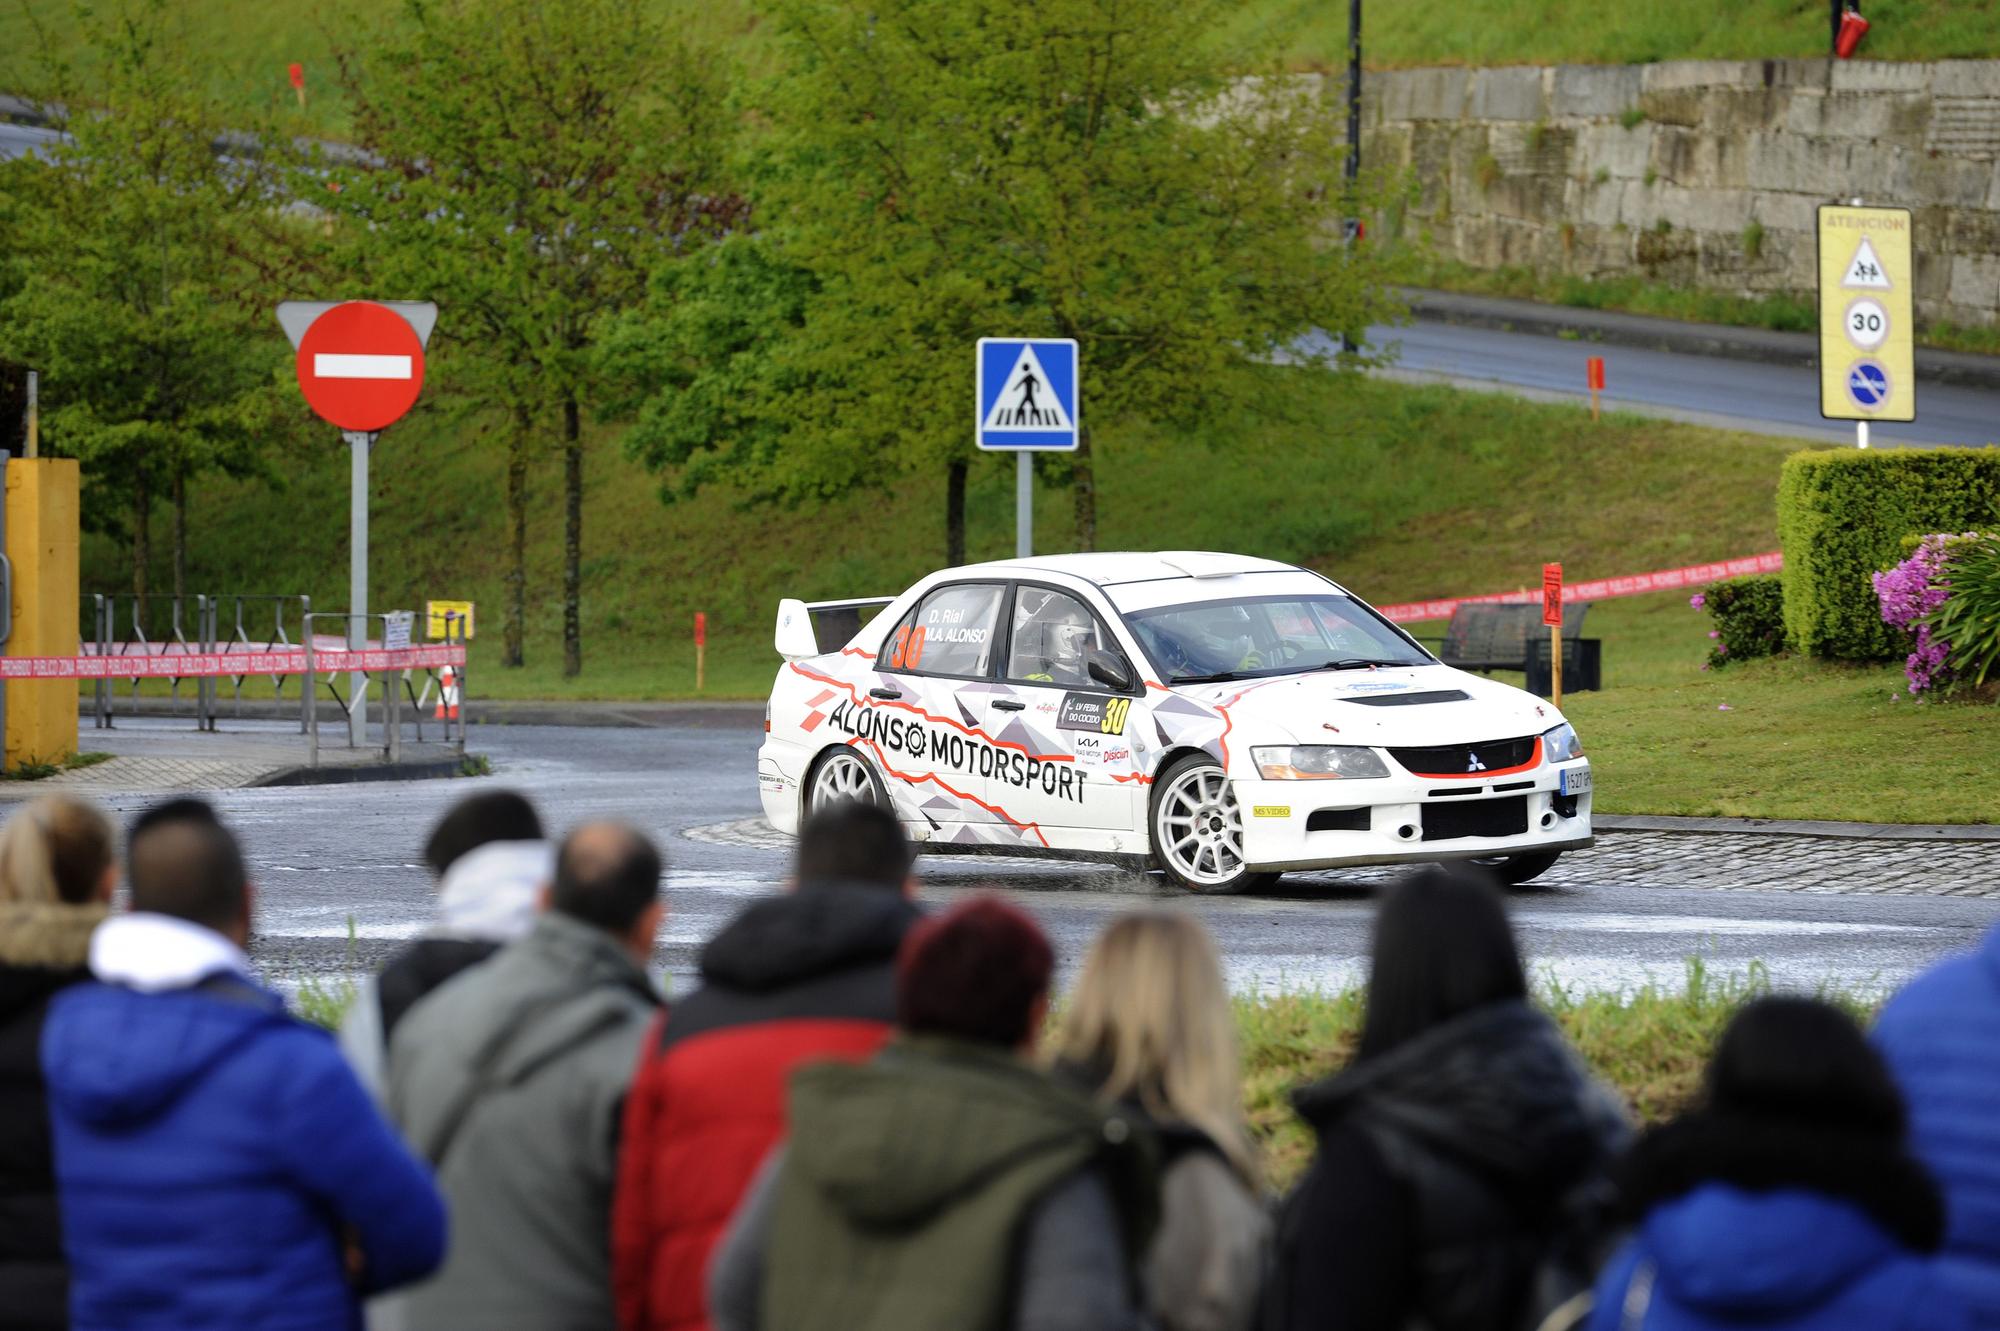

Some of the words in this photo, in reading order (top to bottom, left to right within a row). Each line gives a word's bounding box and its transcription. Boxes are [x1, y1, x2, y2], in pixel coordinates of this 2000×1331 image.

[1853, 313, 1881, 332] 30
[929, 610, 940, 624] D.
[942, 609, 965, 624] Rial
[944, 628, 987, 643] ALONSO
[891, 624, 927, 669] 30
[1069, 713, 1078, 721] DO
[1078, 714, 1100, 724] COCIDO
[1101, 698, 1129, 734] 30
[931, 730, 1088, 803] MOTORSPORT
